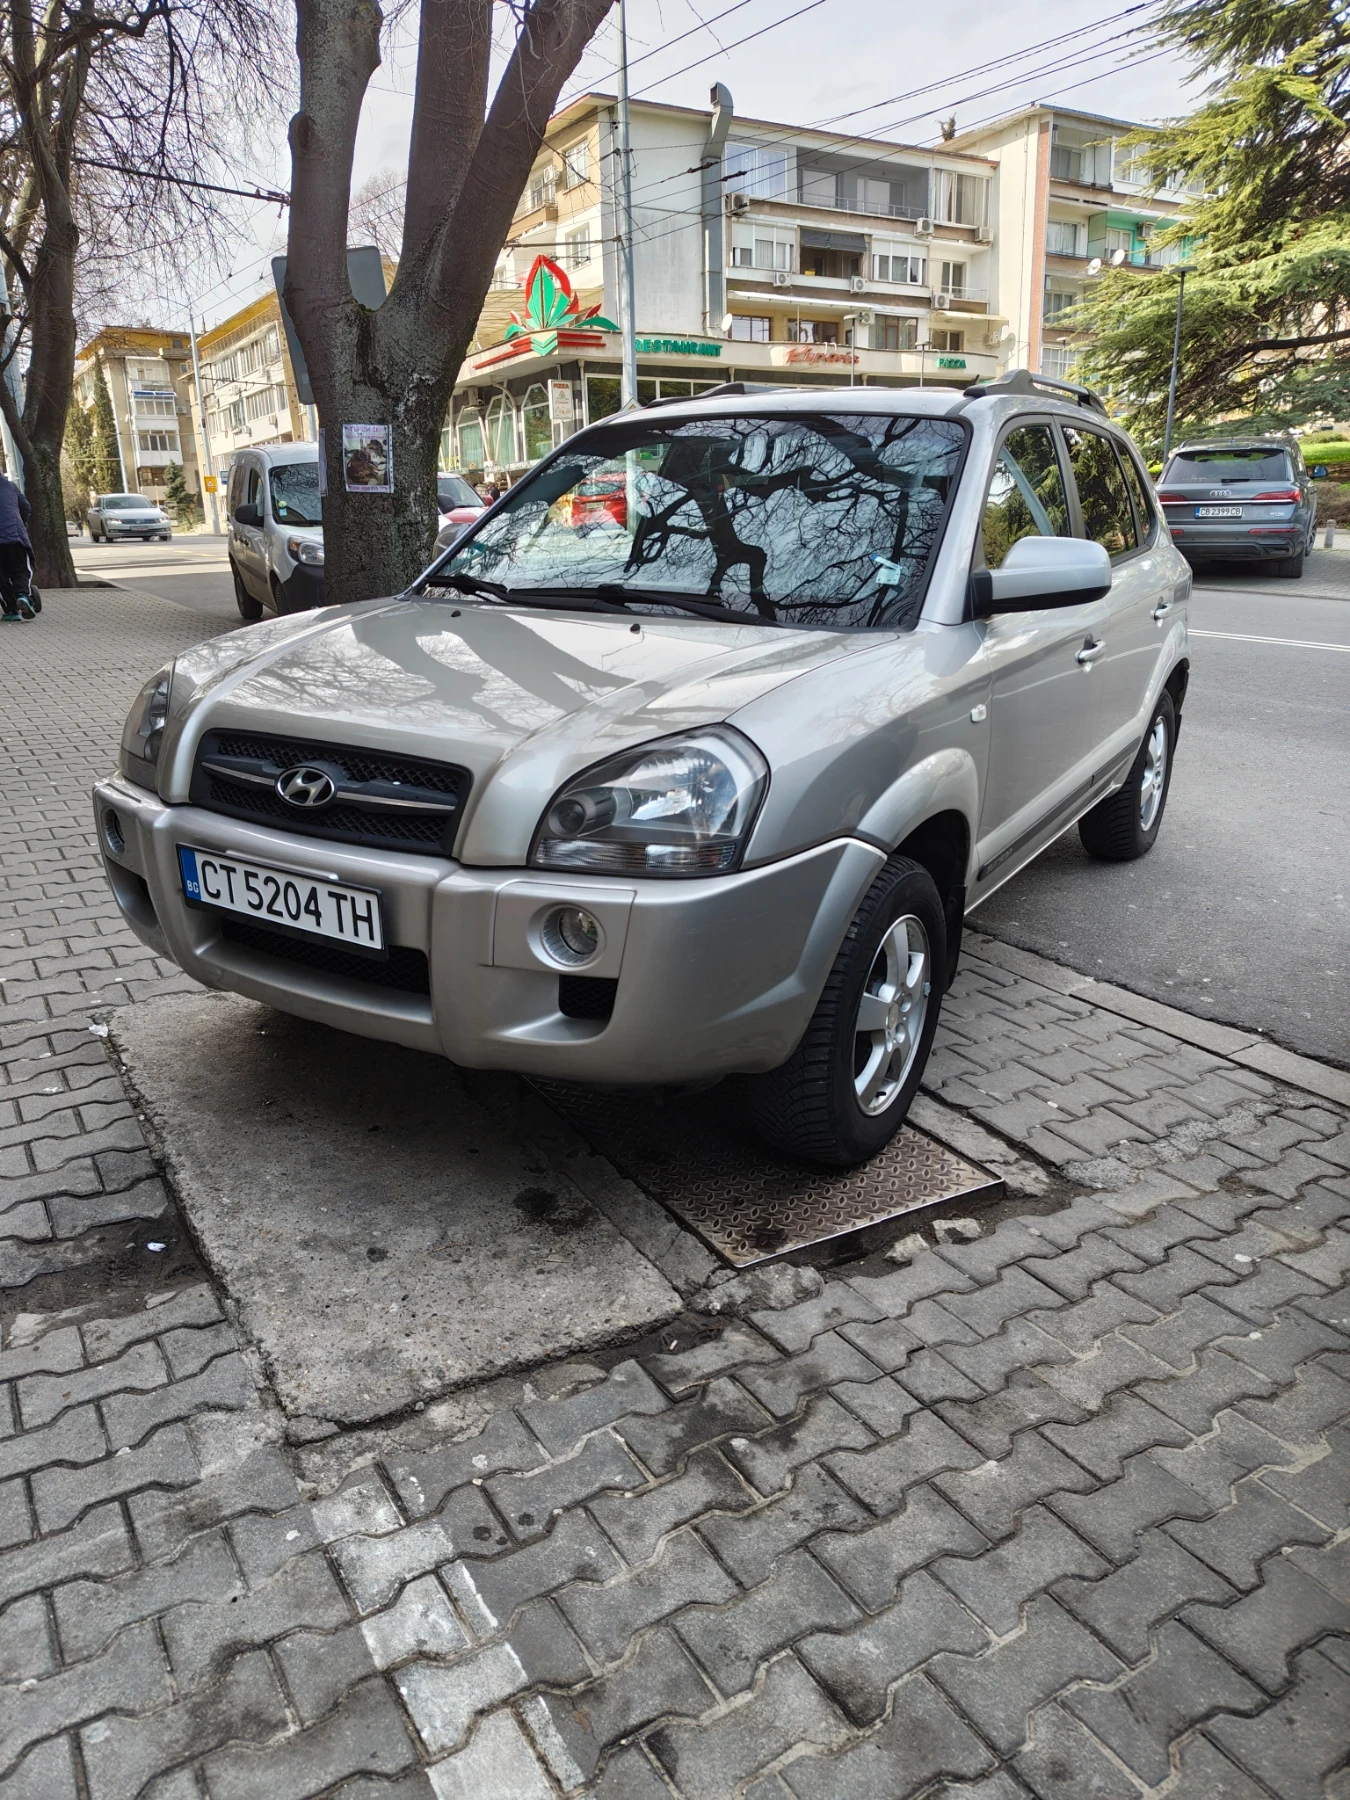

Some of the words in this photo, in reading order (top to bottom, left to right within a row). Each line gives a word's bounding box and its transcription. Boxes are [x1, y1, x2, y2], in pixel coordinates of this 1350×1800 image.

[635, 338, 722, 357] RESTAURANT
[937, 358, 966, 369] PIZZA
[1200, 508, 1210, 516] CB
[1211, 507, 1230, 516] 2399
[1230, 507, 1241, 515] CB
[186, 879, 200, 894] BG
[201, 860, 237, 904] CT
[244, 870, 322, 928] 5204
[327, 890, 375, 942] TH
